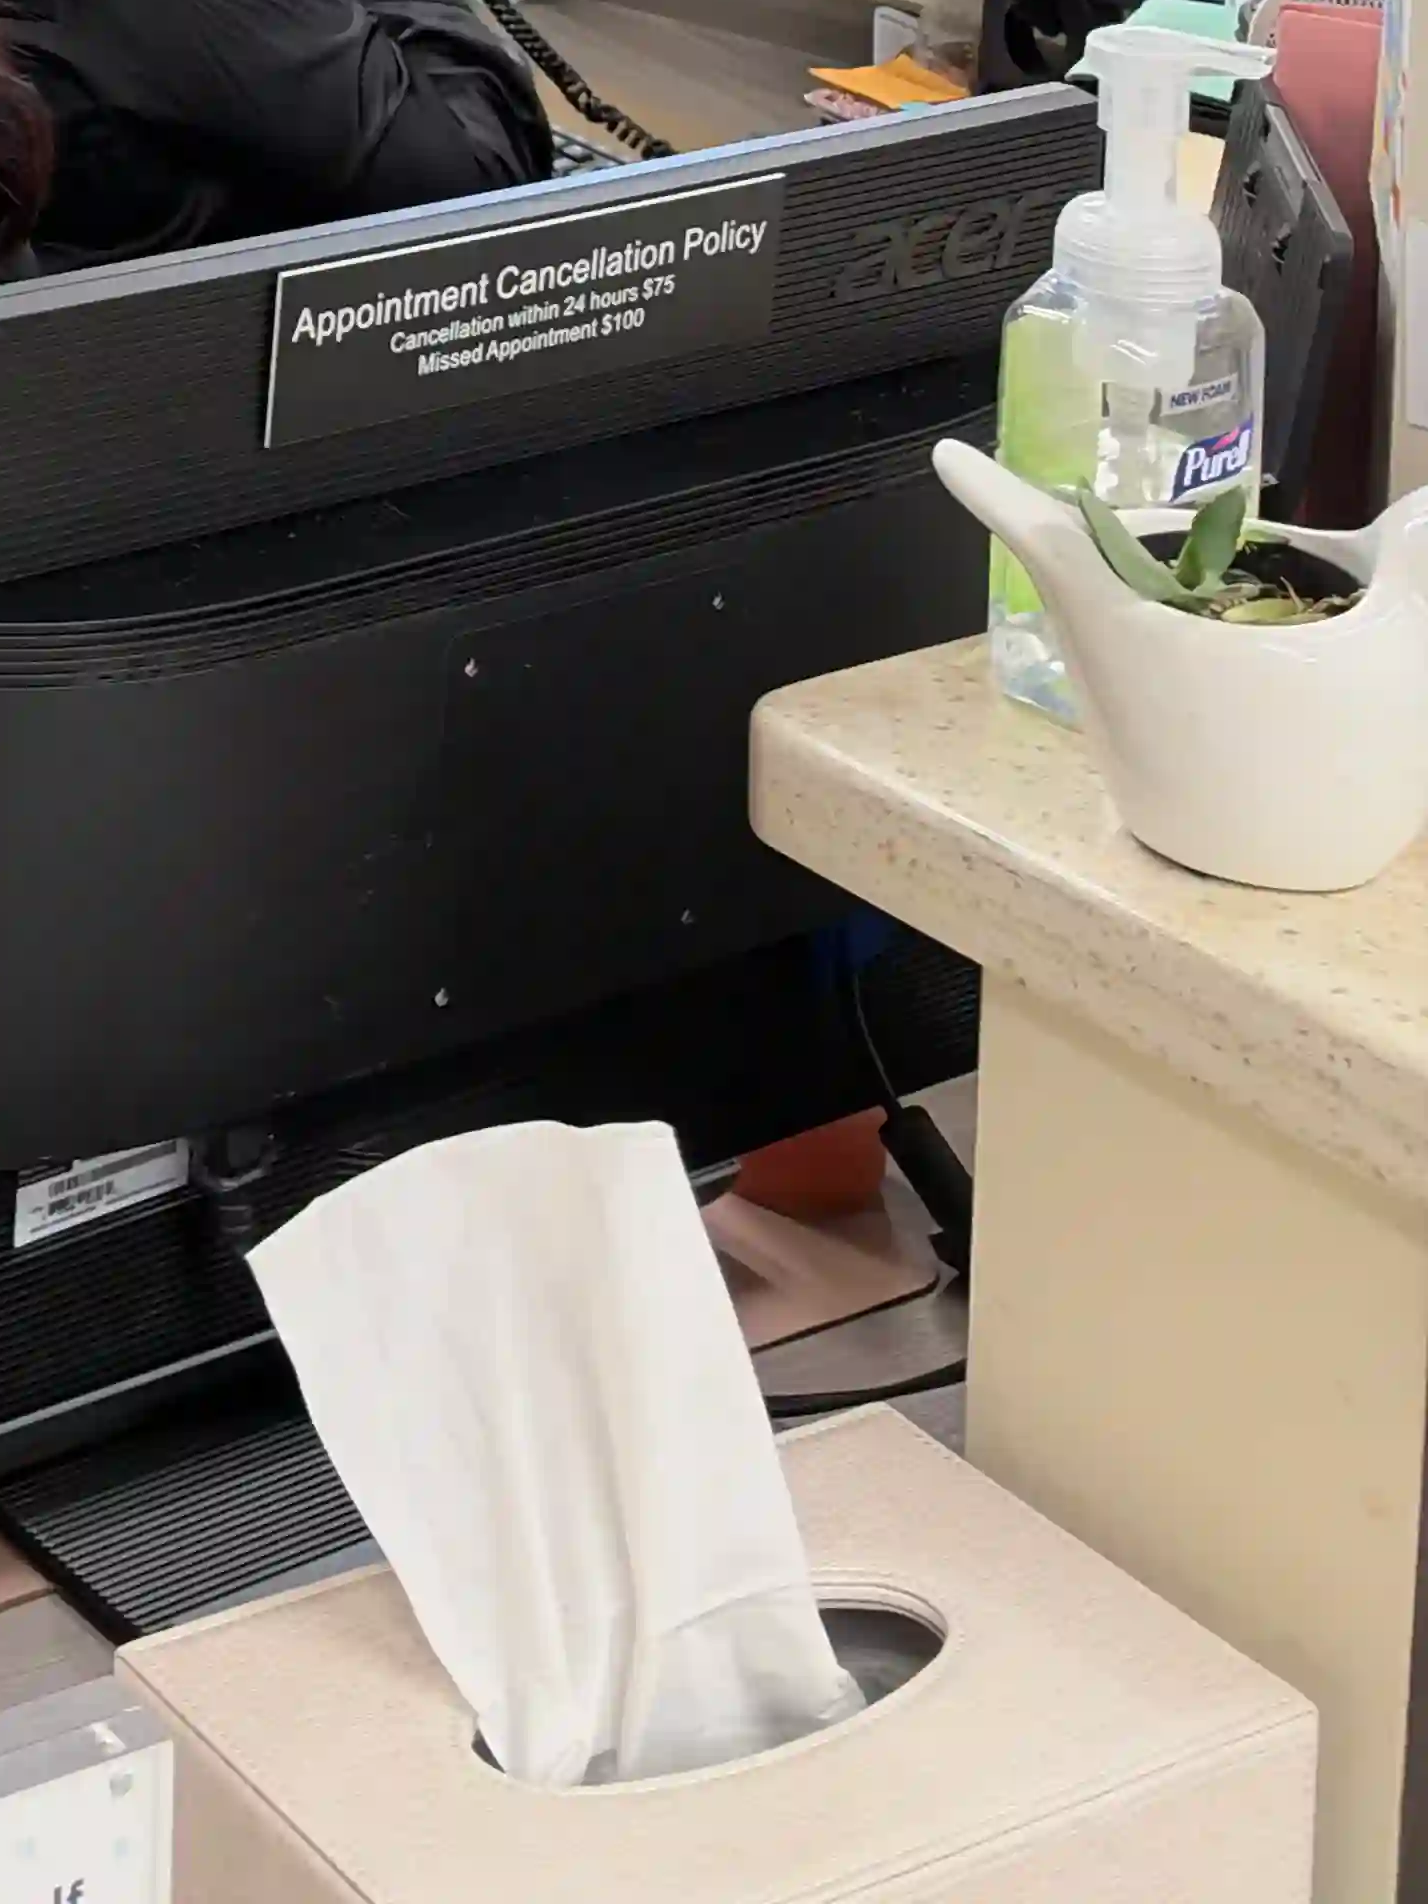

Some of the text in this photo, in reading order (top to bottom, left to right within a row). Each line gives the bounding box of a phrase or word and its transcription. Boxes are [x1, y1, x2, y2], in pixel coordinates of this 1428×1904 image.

[291, 219, 768, 347] Appointment Cancellation Policy
[390, 274, 676, 354] Cancellation within 24 hours $75
[416, 307, 646, 376] Missed Appointment $100
[1183, 429, 1251, 486] Purell
